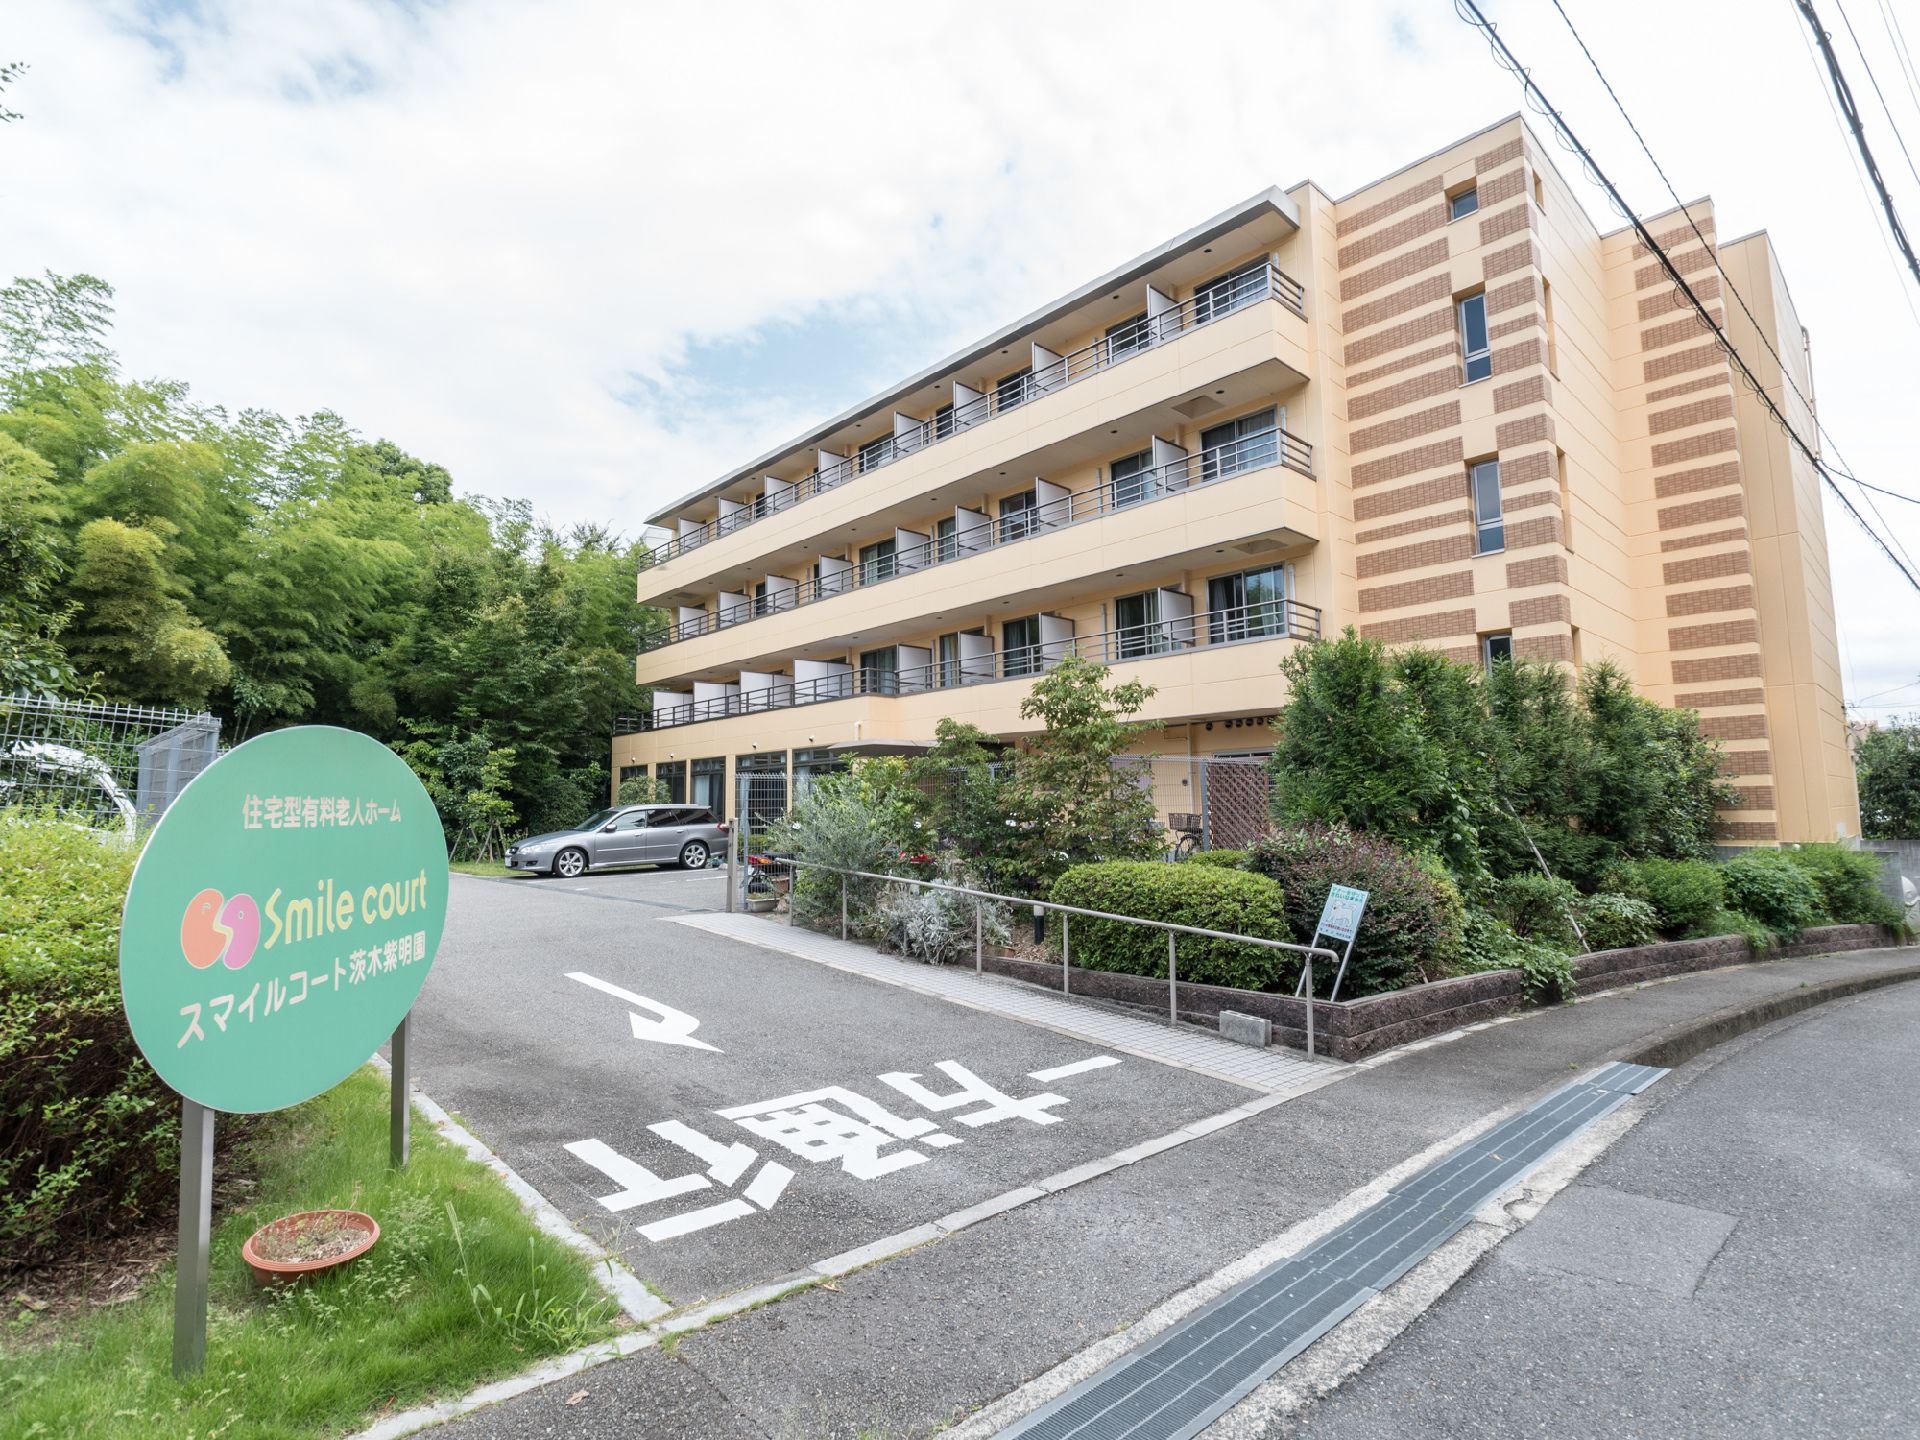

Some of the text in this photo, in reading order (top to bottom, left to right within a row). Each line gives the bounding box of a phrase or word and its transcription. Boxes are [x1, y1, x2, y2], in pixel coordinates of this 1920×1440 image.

[242, 793, 402, 830] 住宅型有料老人ホーム
[263, 869, 428, 950] Smile court
[176, 930, 427, 1049] スマイルコート茨木紫明園
[562, 1054, 1124, 1243] 一方通行
